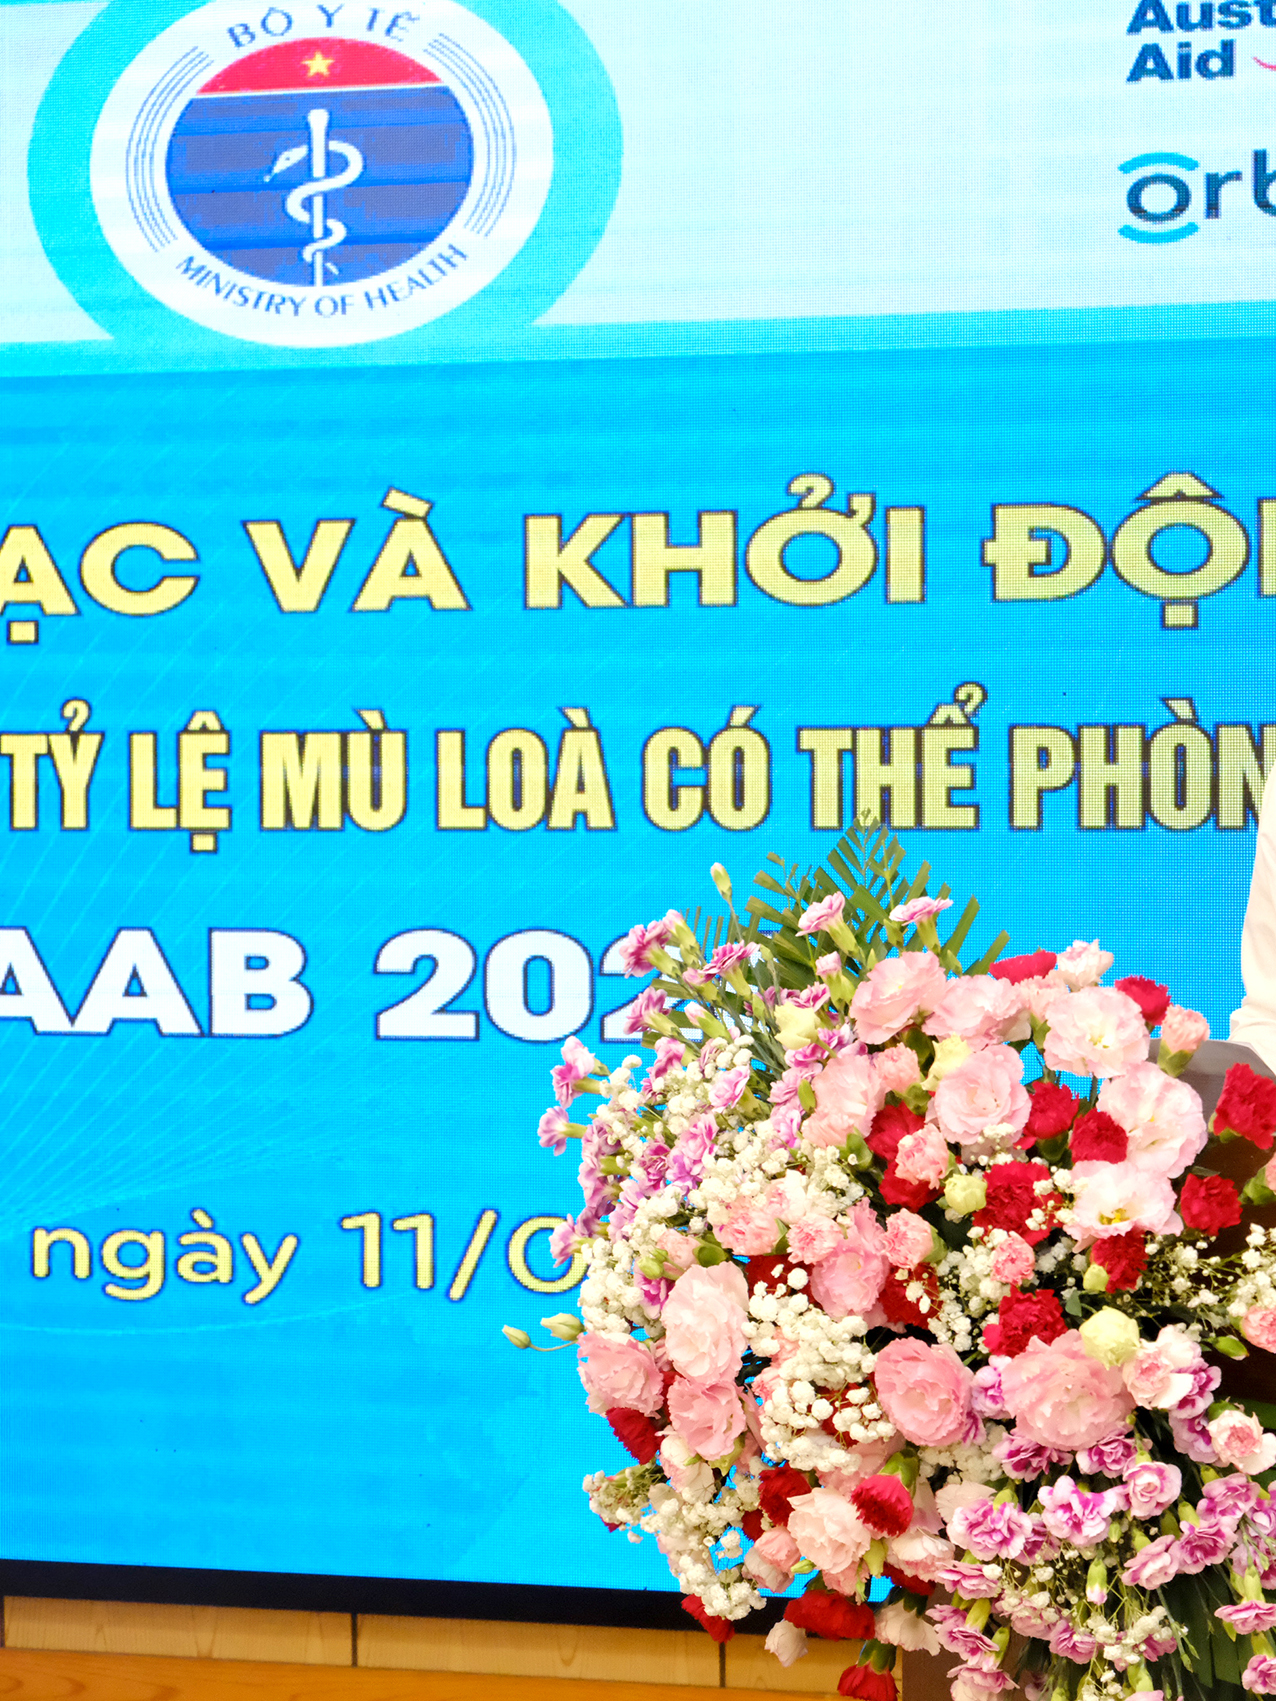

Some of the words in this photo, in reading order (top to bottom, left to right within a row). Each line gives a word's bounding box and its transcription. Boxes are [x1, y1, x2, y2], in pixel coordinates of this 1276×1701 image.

[316, 3, 345, 28] Y
[1126, 39, 1236, 83] Aid
[175, 255, 306, 317] MINISTRY
[314, 295, 354, 318] OF
[364, 243, 468, 310] HEALTH
[242, 486, 473, 613] VÀ
[523, 473, 926, 610] KHỞI
[0, 697, 103, 831] TỶ
[128, 709, 231, 854] LỆ
[258, 707, 408, 832] MÙ
[435, 705, 617, 832] LOÀ
[641, 705, 771, 832] CÓ
[797, 681, 989, 831] THỂ
[373, 928, 785, 1043] 202
[31, 1208, 299, 1305] ngày
